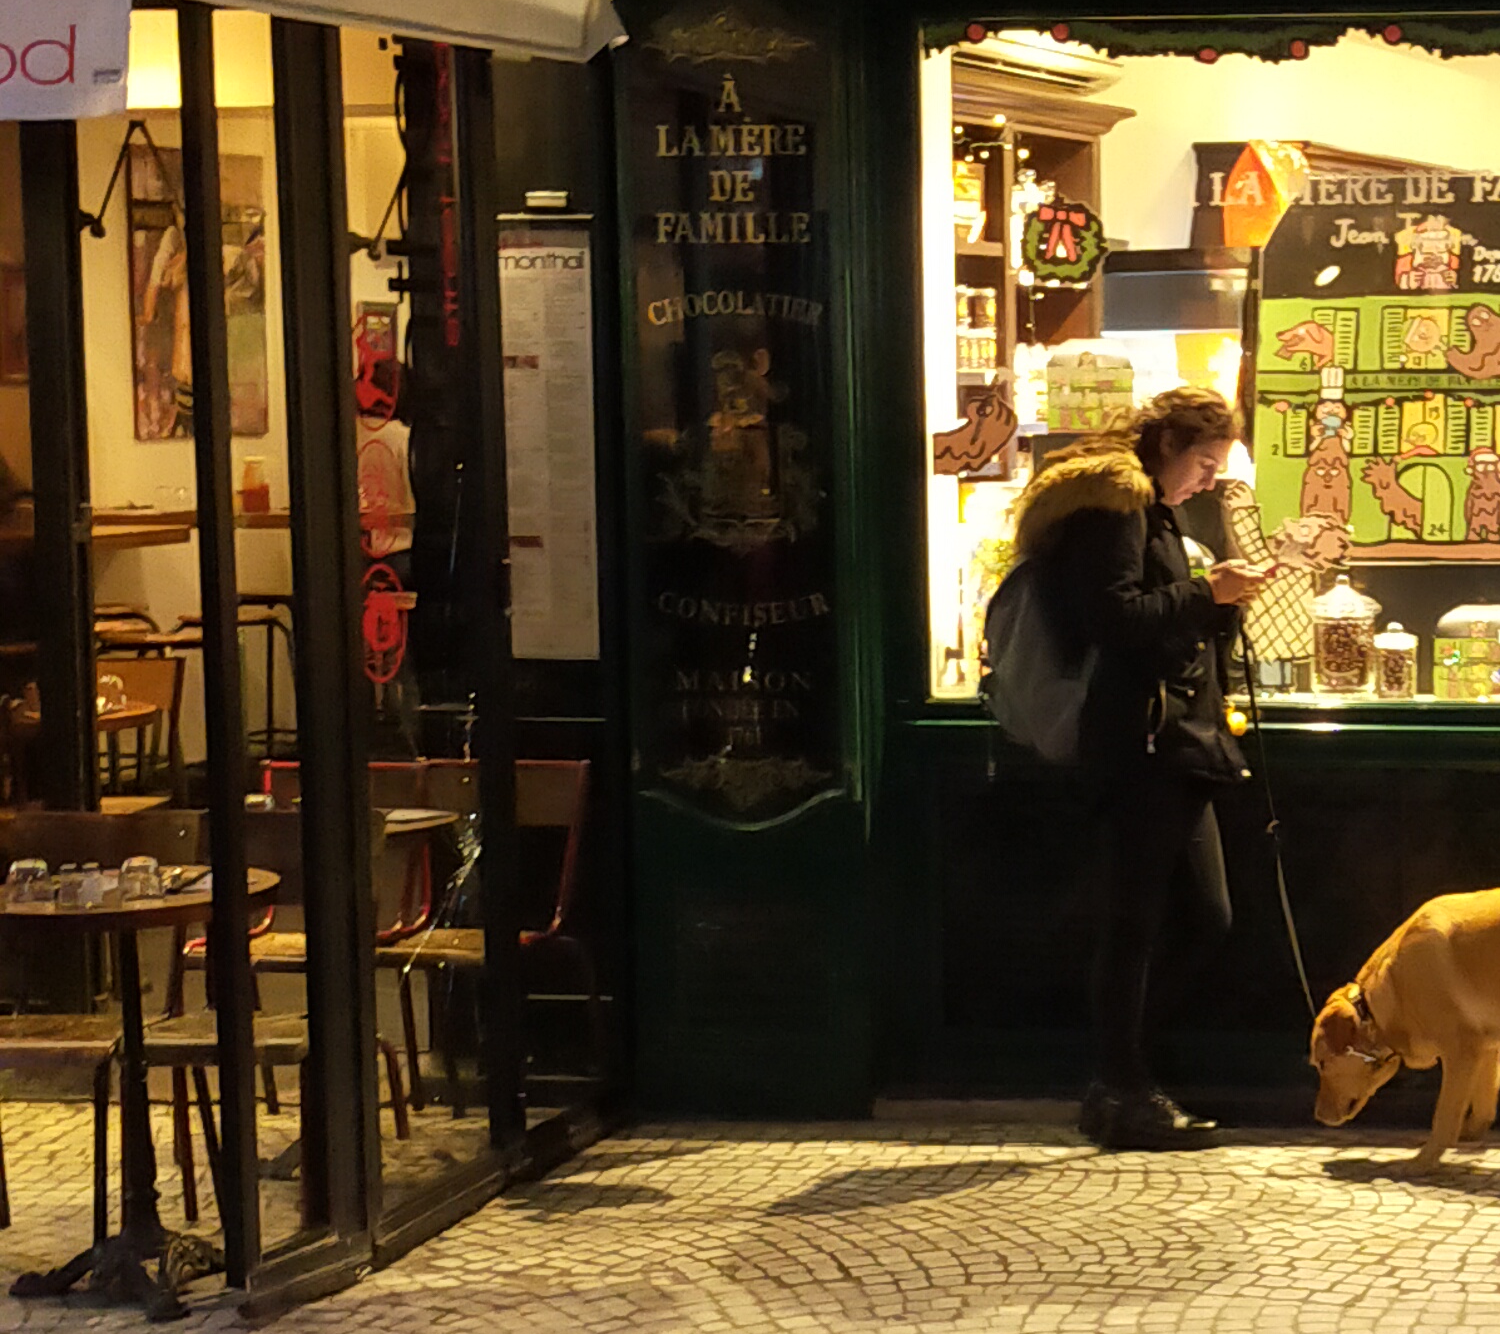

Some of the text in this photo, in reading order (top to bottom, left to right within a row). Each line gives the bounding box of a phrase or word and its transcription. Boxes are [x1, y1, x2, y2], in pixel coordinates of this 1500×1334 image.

[717, 72, 742, 113] À
[655, 116, 808, 157] LA MÈRE
[708, 168, 756, 203] DE
[1401, 168, 1456, 205] DE
[655, 210, 813, 245] FAMILLE
[1329, 217, 1391, 248] Jean
[647, 289, 824, 326] CHOCOLATIER
[657, 590, 832, 628] CONFISEUR
